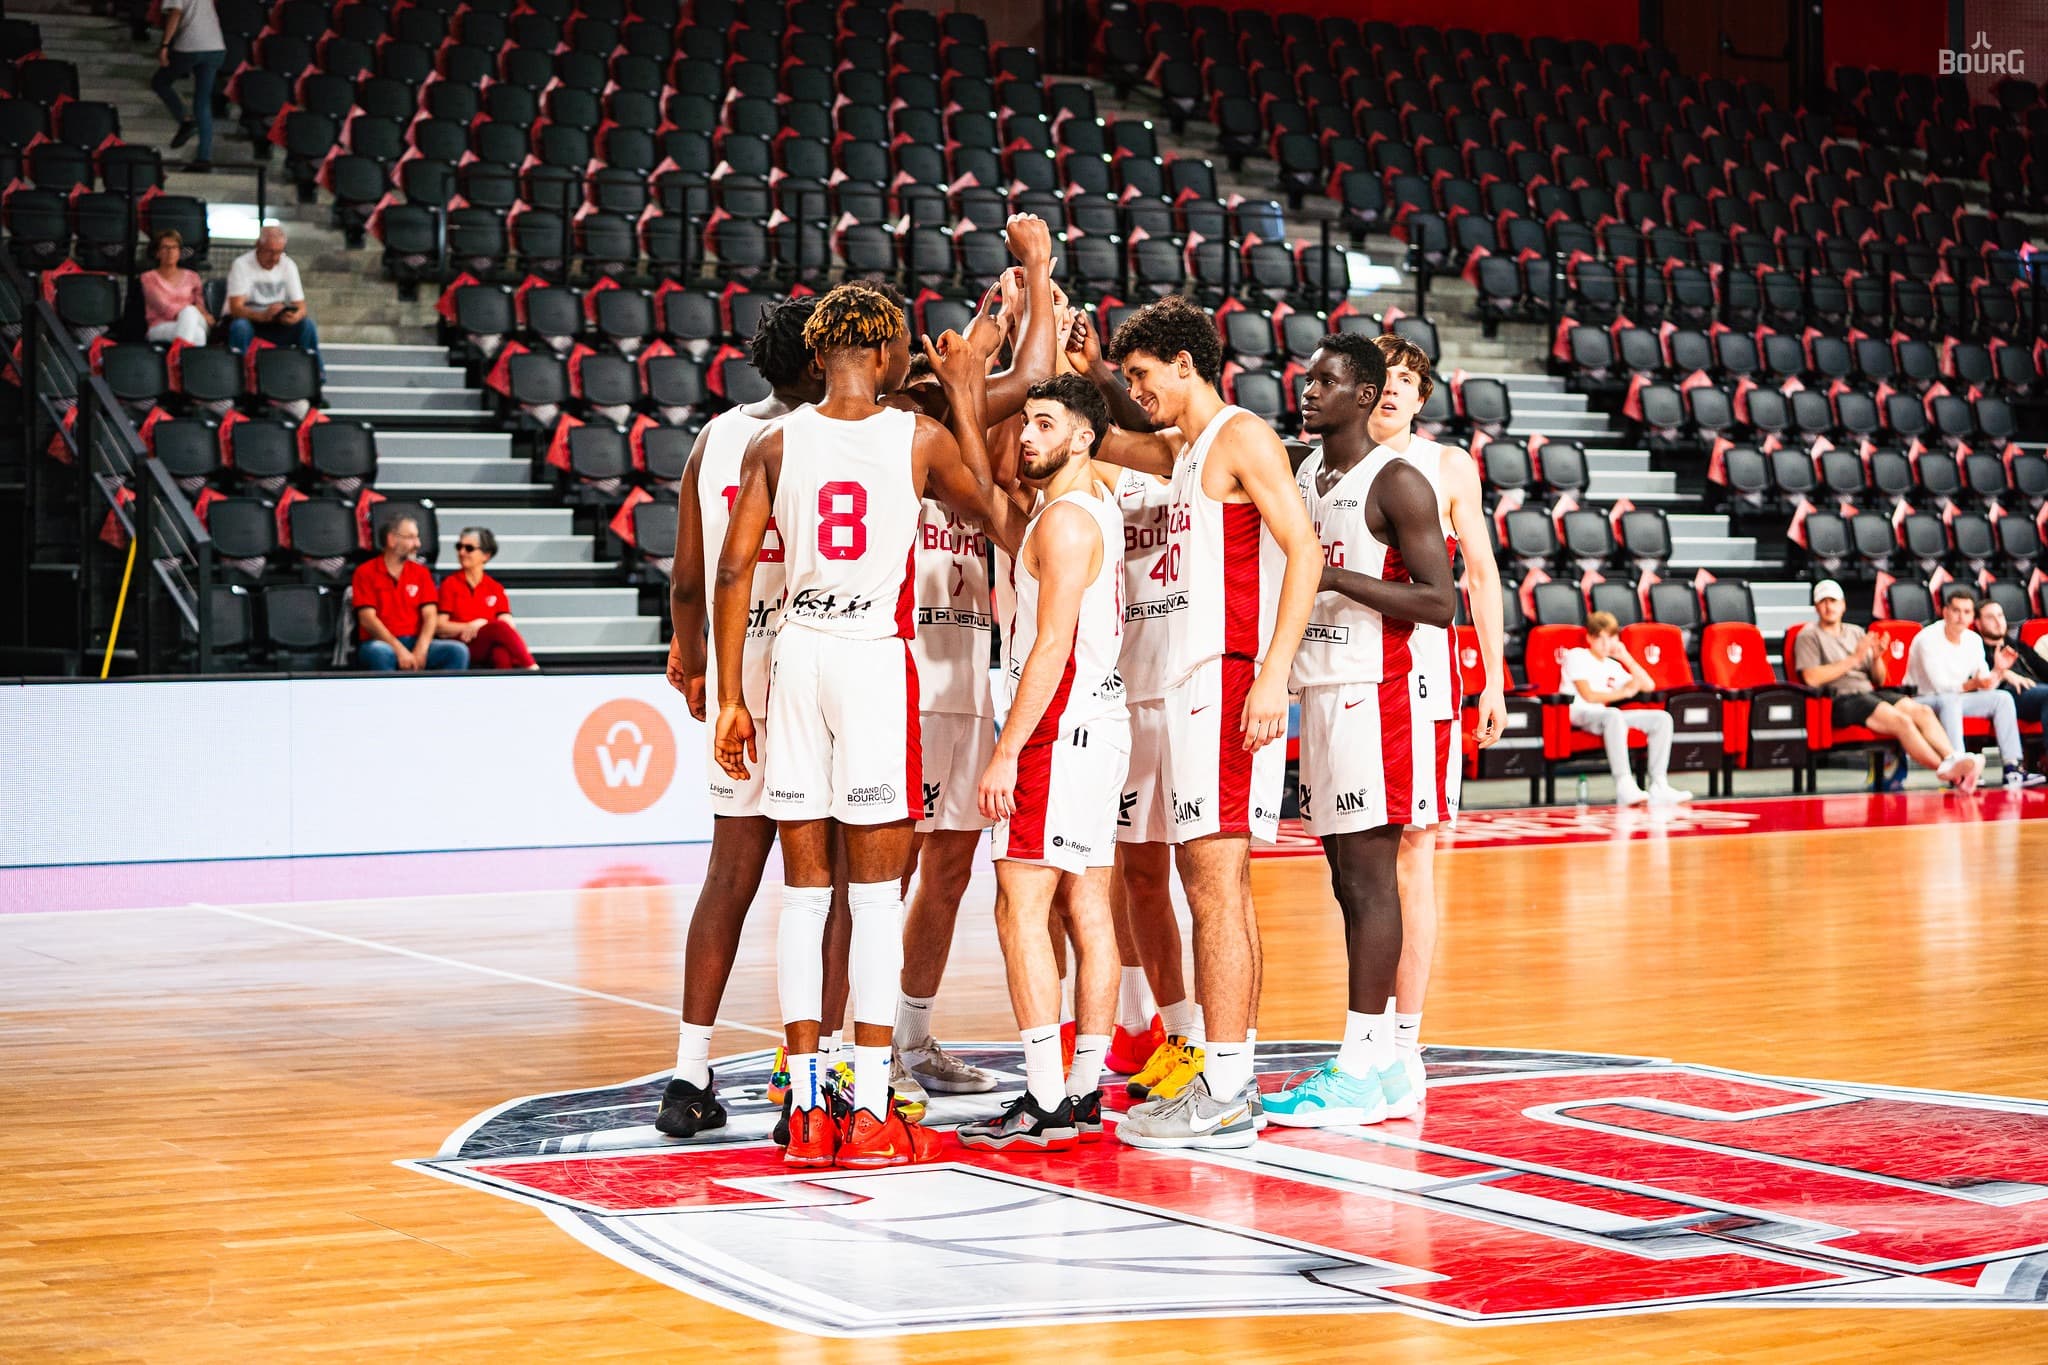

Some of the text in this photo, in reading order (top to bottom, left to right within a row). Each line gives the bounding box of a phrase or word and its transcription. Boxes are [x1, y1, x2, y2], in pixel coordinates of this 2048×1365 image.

[818, 481, 868, 561] 8
[1418, 674, 1428, 699] 6
[775, 790, 805, 799] Région
[847, 794, 880, 802] BOURG
[852, 786, 879, 794] GRAND
[1179, 802, 1200, 821] AIN
[1336, 792, 1364, 812] AIN
